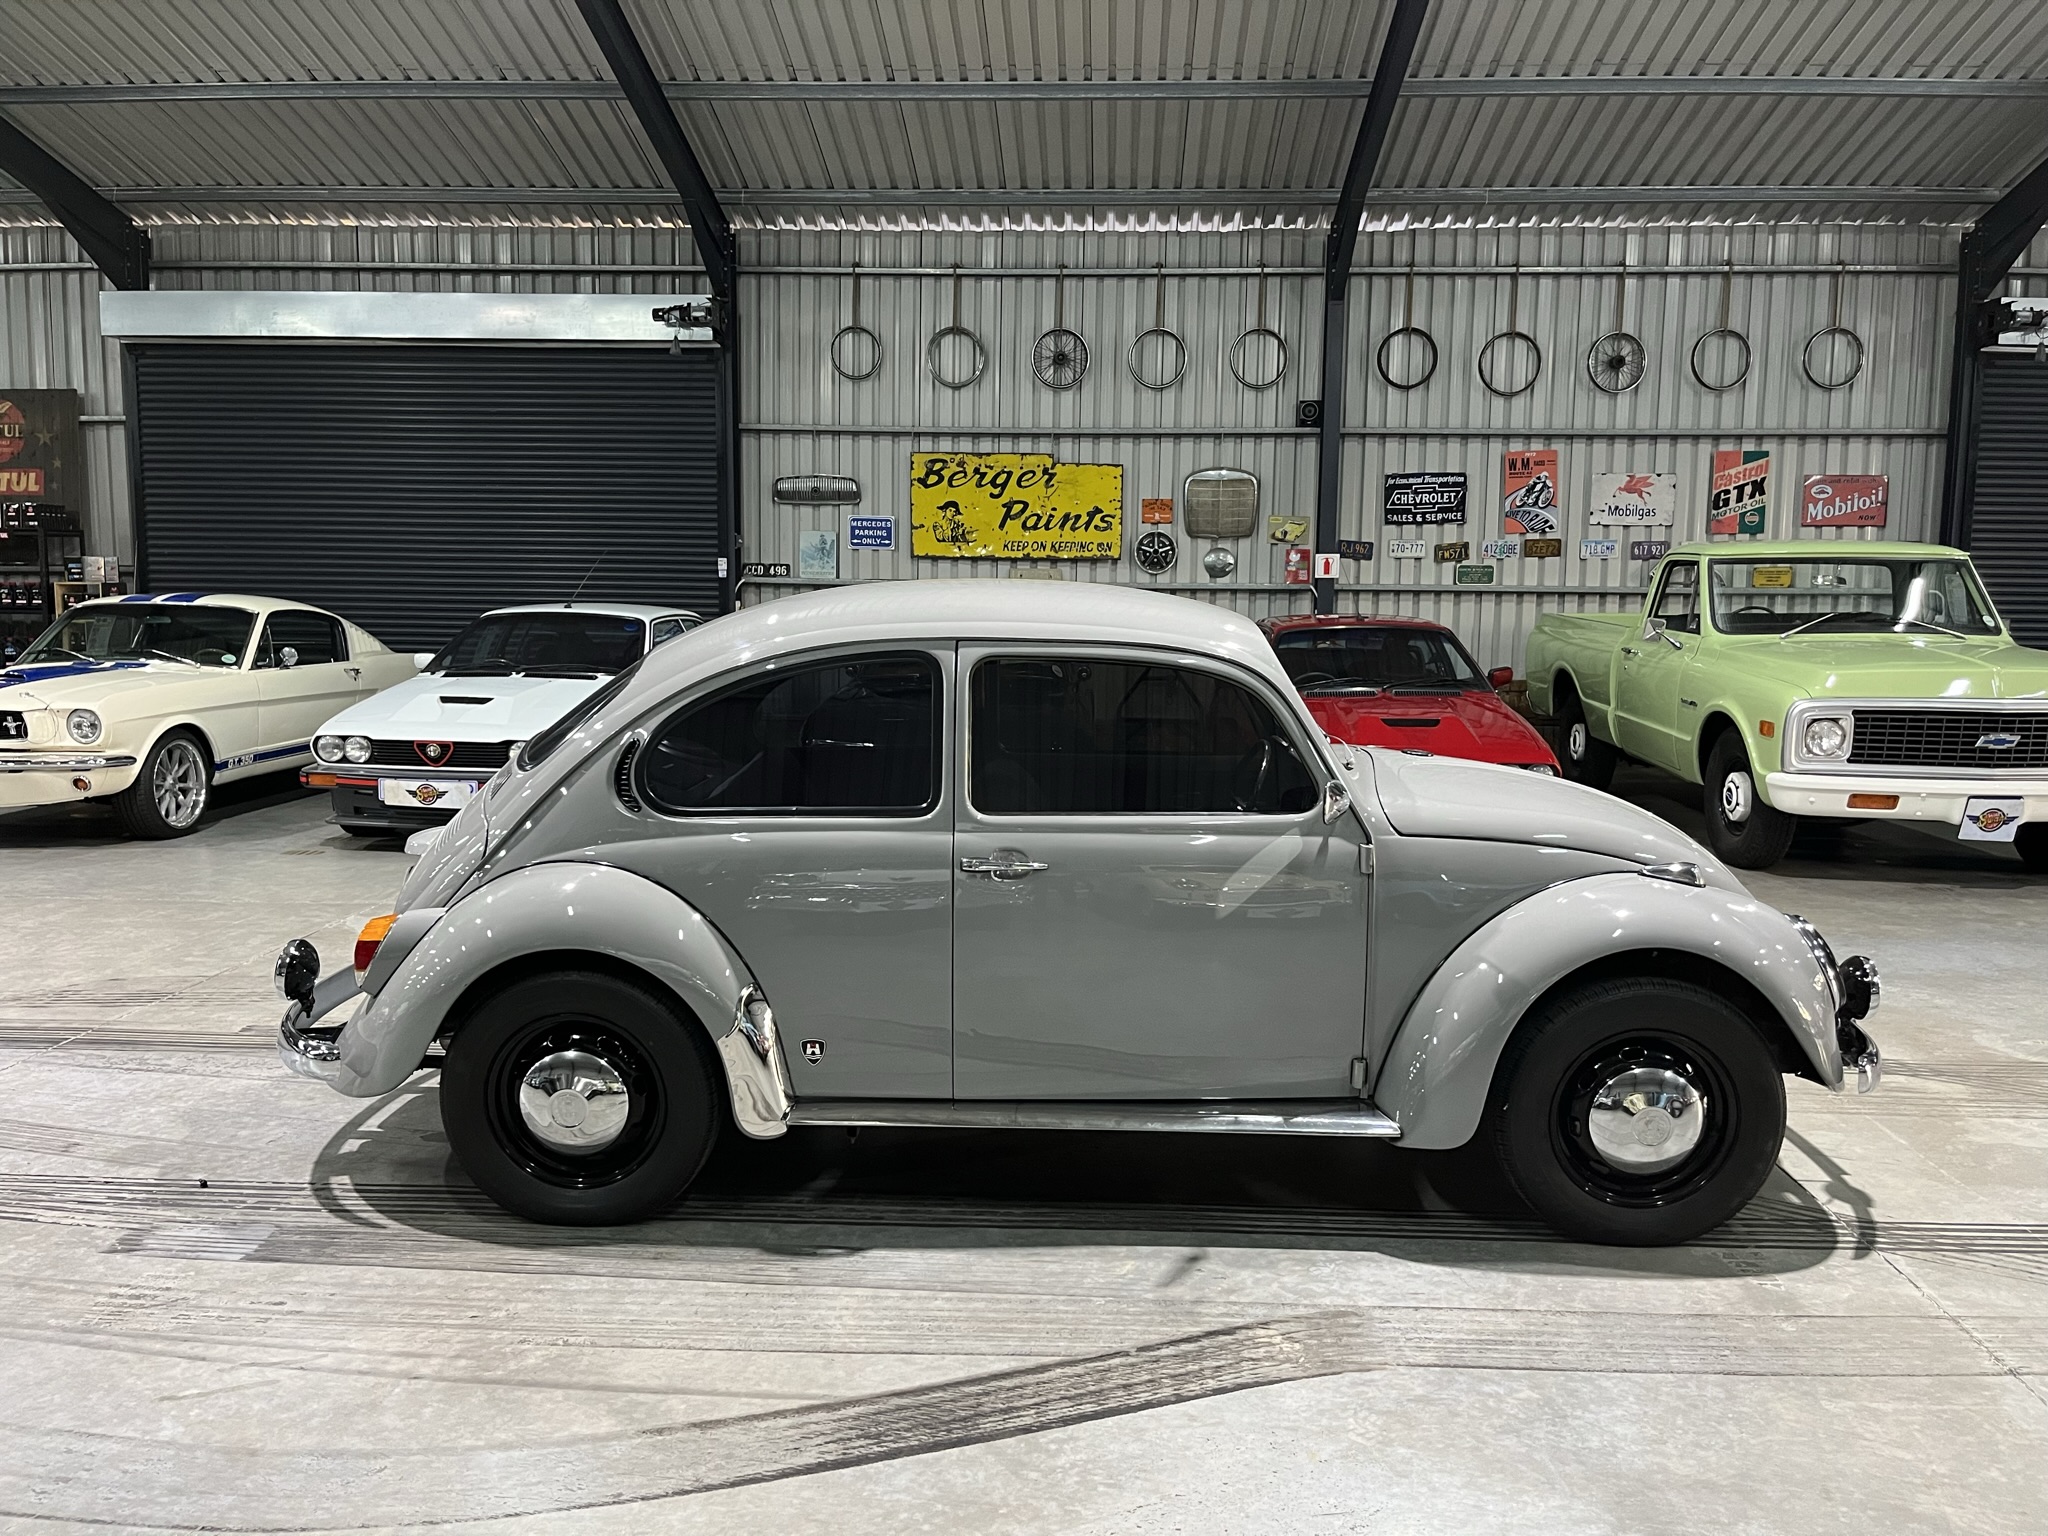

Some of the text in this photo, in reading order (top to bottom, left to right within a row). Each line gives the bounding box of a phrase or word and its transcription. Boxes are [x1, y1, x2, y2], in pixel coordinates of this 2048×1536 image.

[917, 458, 1057, 499] Berger
[1714, 459, 1769, 490] Castrol
[1394, 492, 1456, 504] CHEVROLET
[1712, 476, 1767, 511] GTX
[1711, 498, 1766, 521] MOTOR OIL
[1806, 486, 1882, 522] Mobiloil
[999, 499, 1116, 533] Paints
[1387, 514, 1413, 522] SALES
[1426, 512, 1462, 521] SERVICE
[1520, 510, 1531, 521] TO
[1607, 504, 1656, 520] Mobilgas
[1003, 540, 1029, 552] KEEP
[1031, 541, 1046, 552] ON
[1097, 542, 1112, 552] ON
[1396, 544, 1424, 553] 70-777
[1484, 544, 1498, 554] 412
[1635, 545, 1664, 555] 617 921
[769, 565, 787, 575] 496
[241, 754, 253, 766] 350
